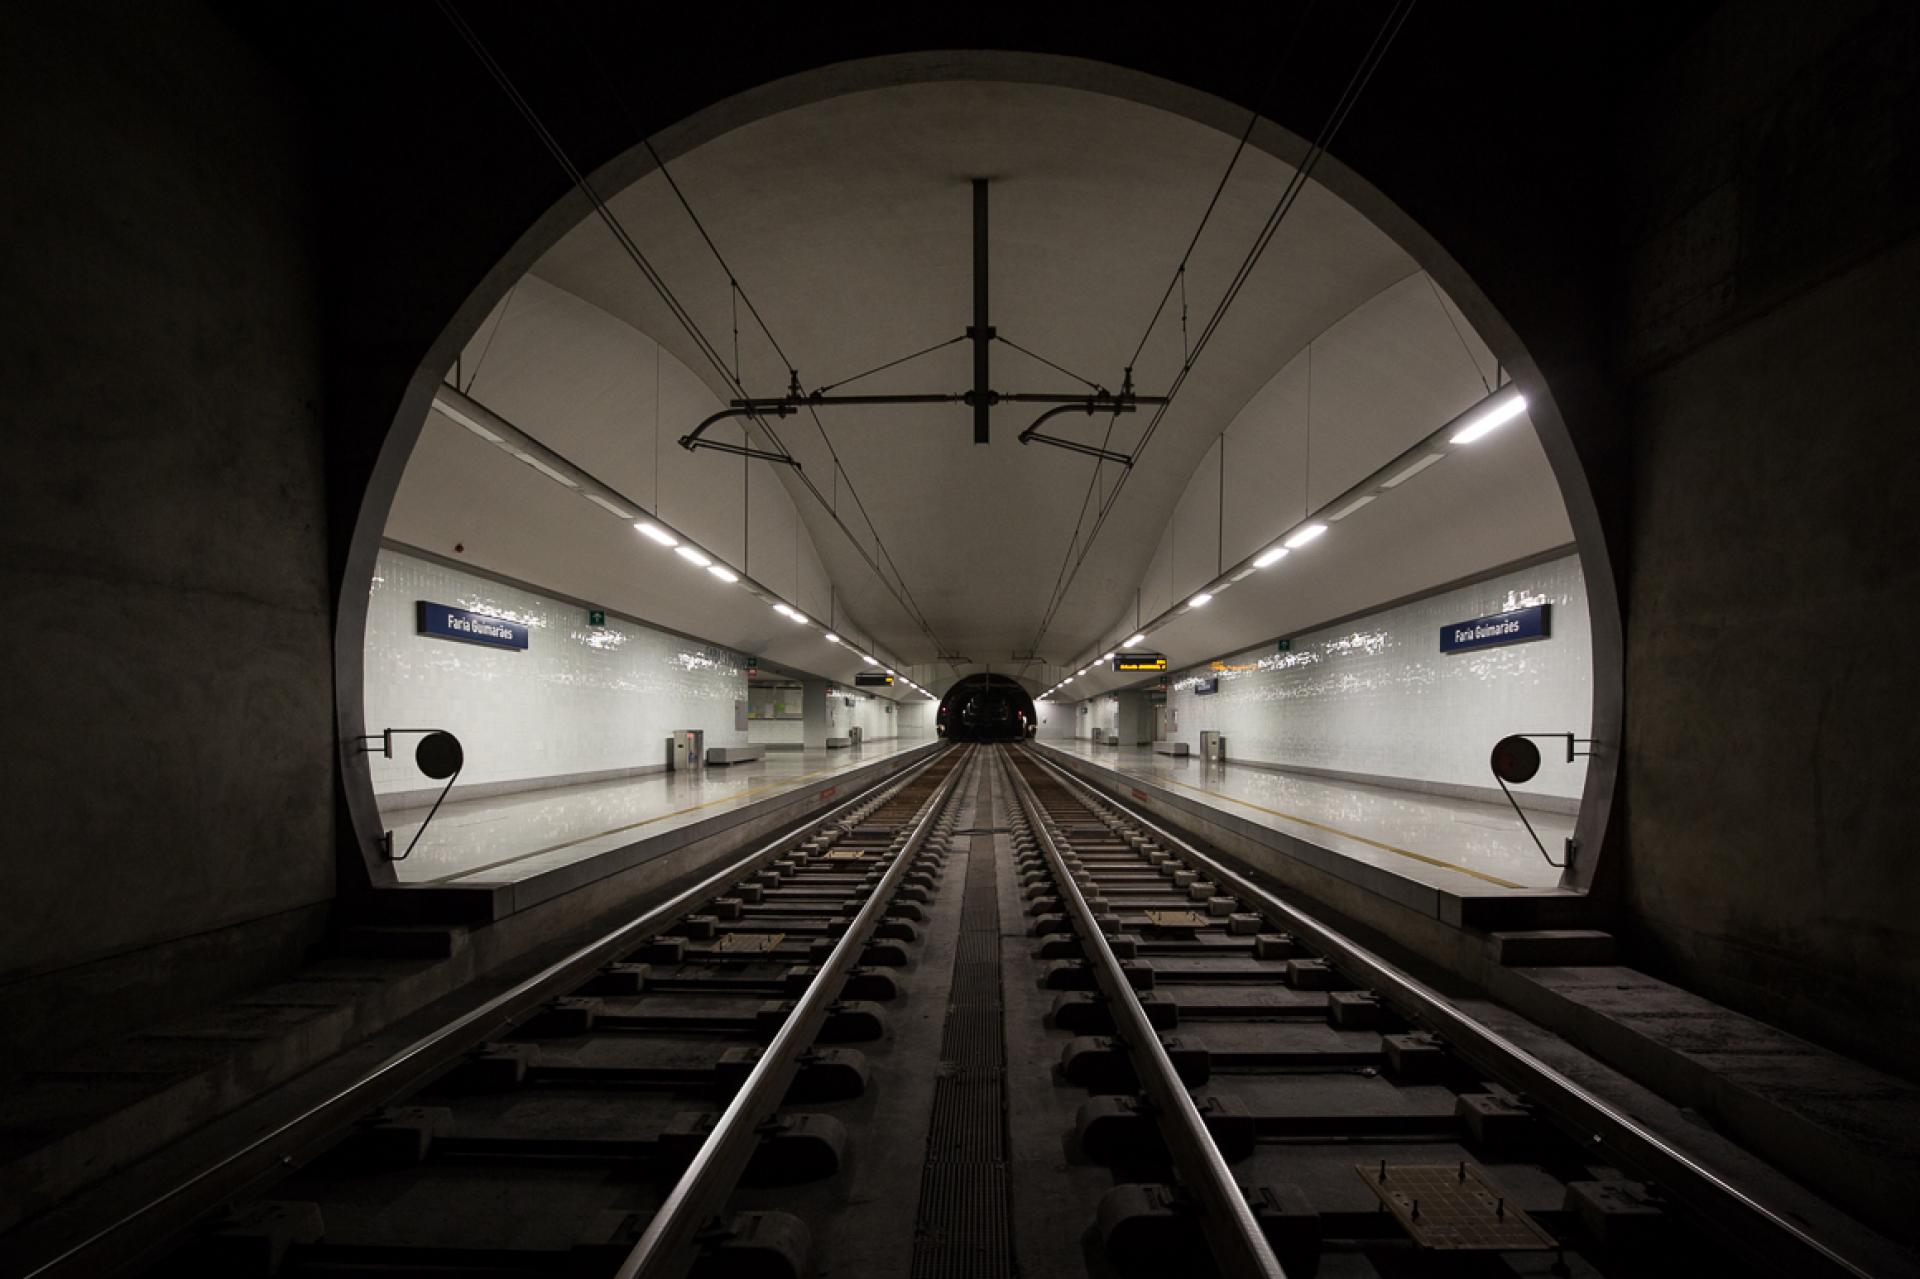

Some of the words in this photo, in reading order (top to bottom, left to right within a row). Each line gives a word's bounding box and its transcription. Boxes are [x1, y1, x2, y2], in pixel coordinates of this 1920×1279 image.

[448, 613, 470, 632] Faria
[471, 619, 512, 640] Guimarães
[1455, 627, 1473, 642] Faria
[1475, 620, 1520, 639] Guimarães
